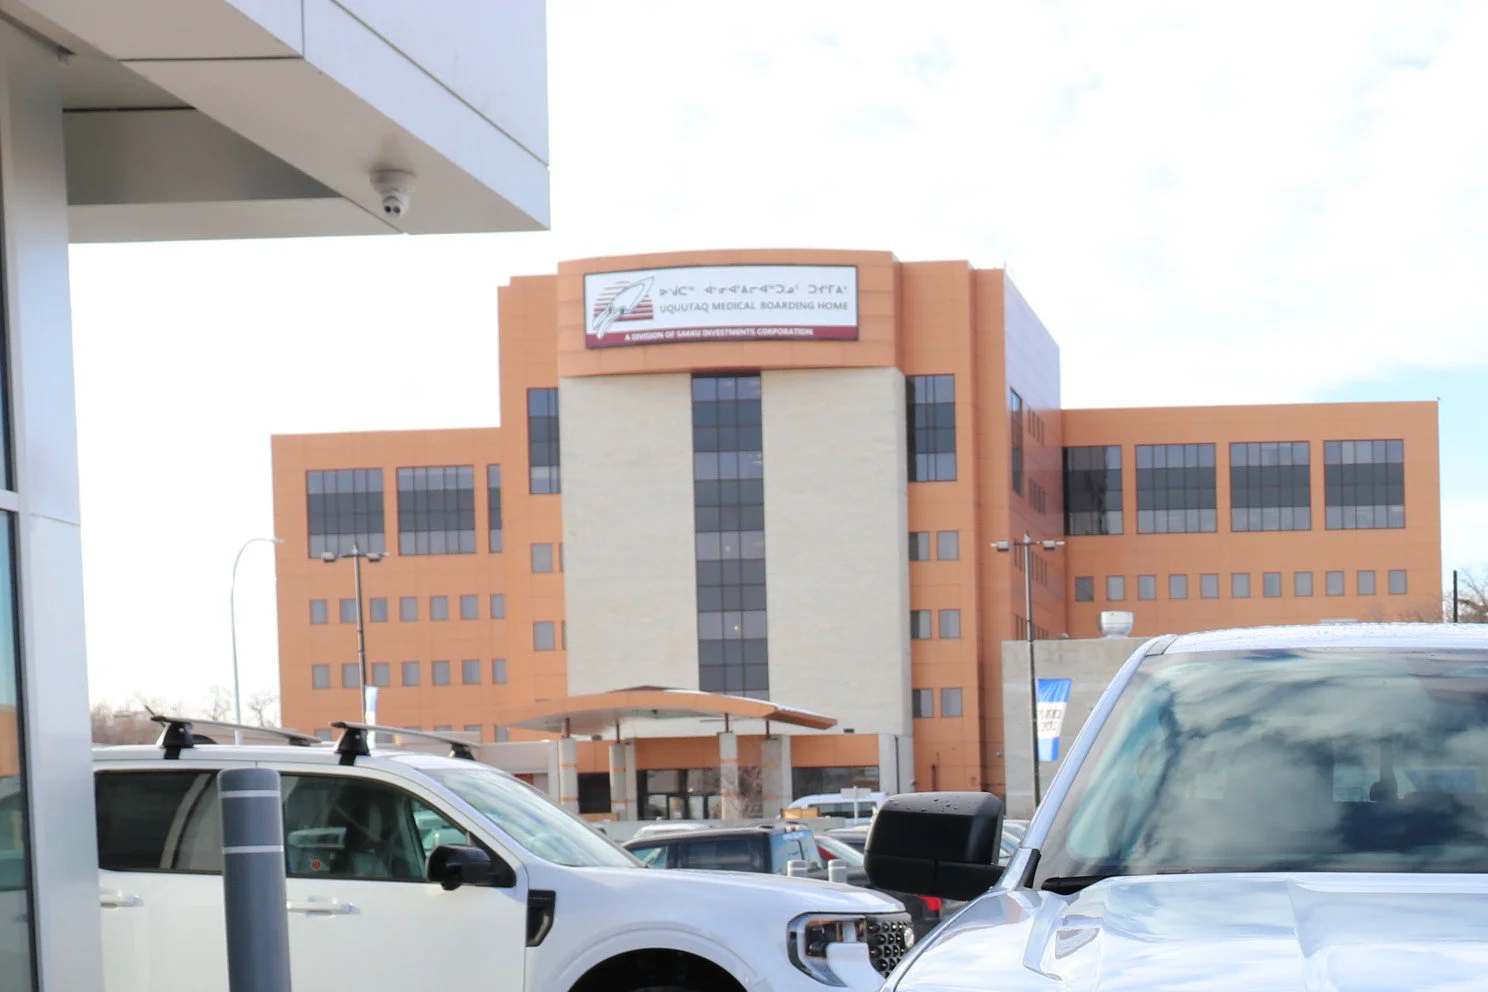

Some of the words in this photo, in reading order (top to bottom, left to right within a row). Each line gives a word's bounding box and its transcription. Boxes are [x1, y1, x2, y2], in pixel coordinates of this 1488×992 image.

[659, 302, 710, 314] UQUUTAQ
[711, 301, 756, 311] MEDICAL
[760, 300, 815, 310] BOARDING
[817, 300, 849, 310] HOME
[624, 332, 631, 342] A
[631, 331, 664, 341] DIVISION
[665, 330, 675, 339] OF
[702, 328, 756, 337] INVESTMENTS
[757, 327, 814, 336] CORPORATION
